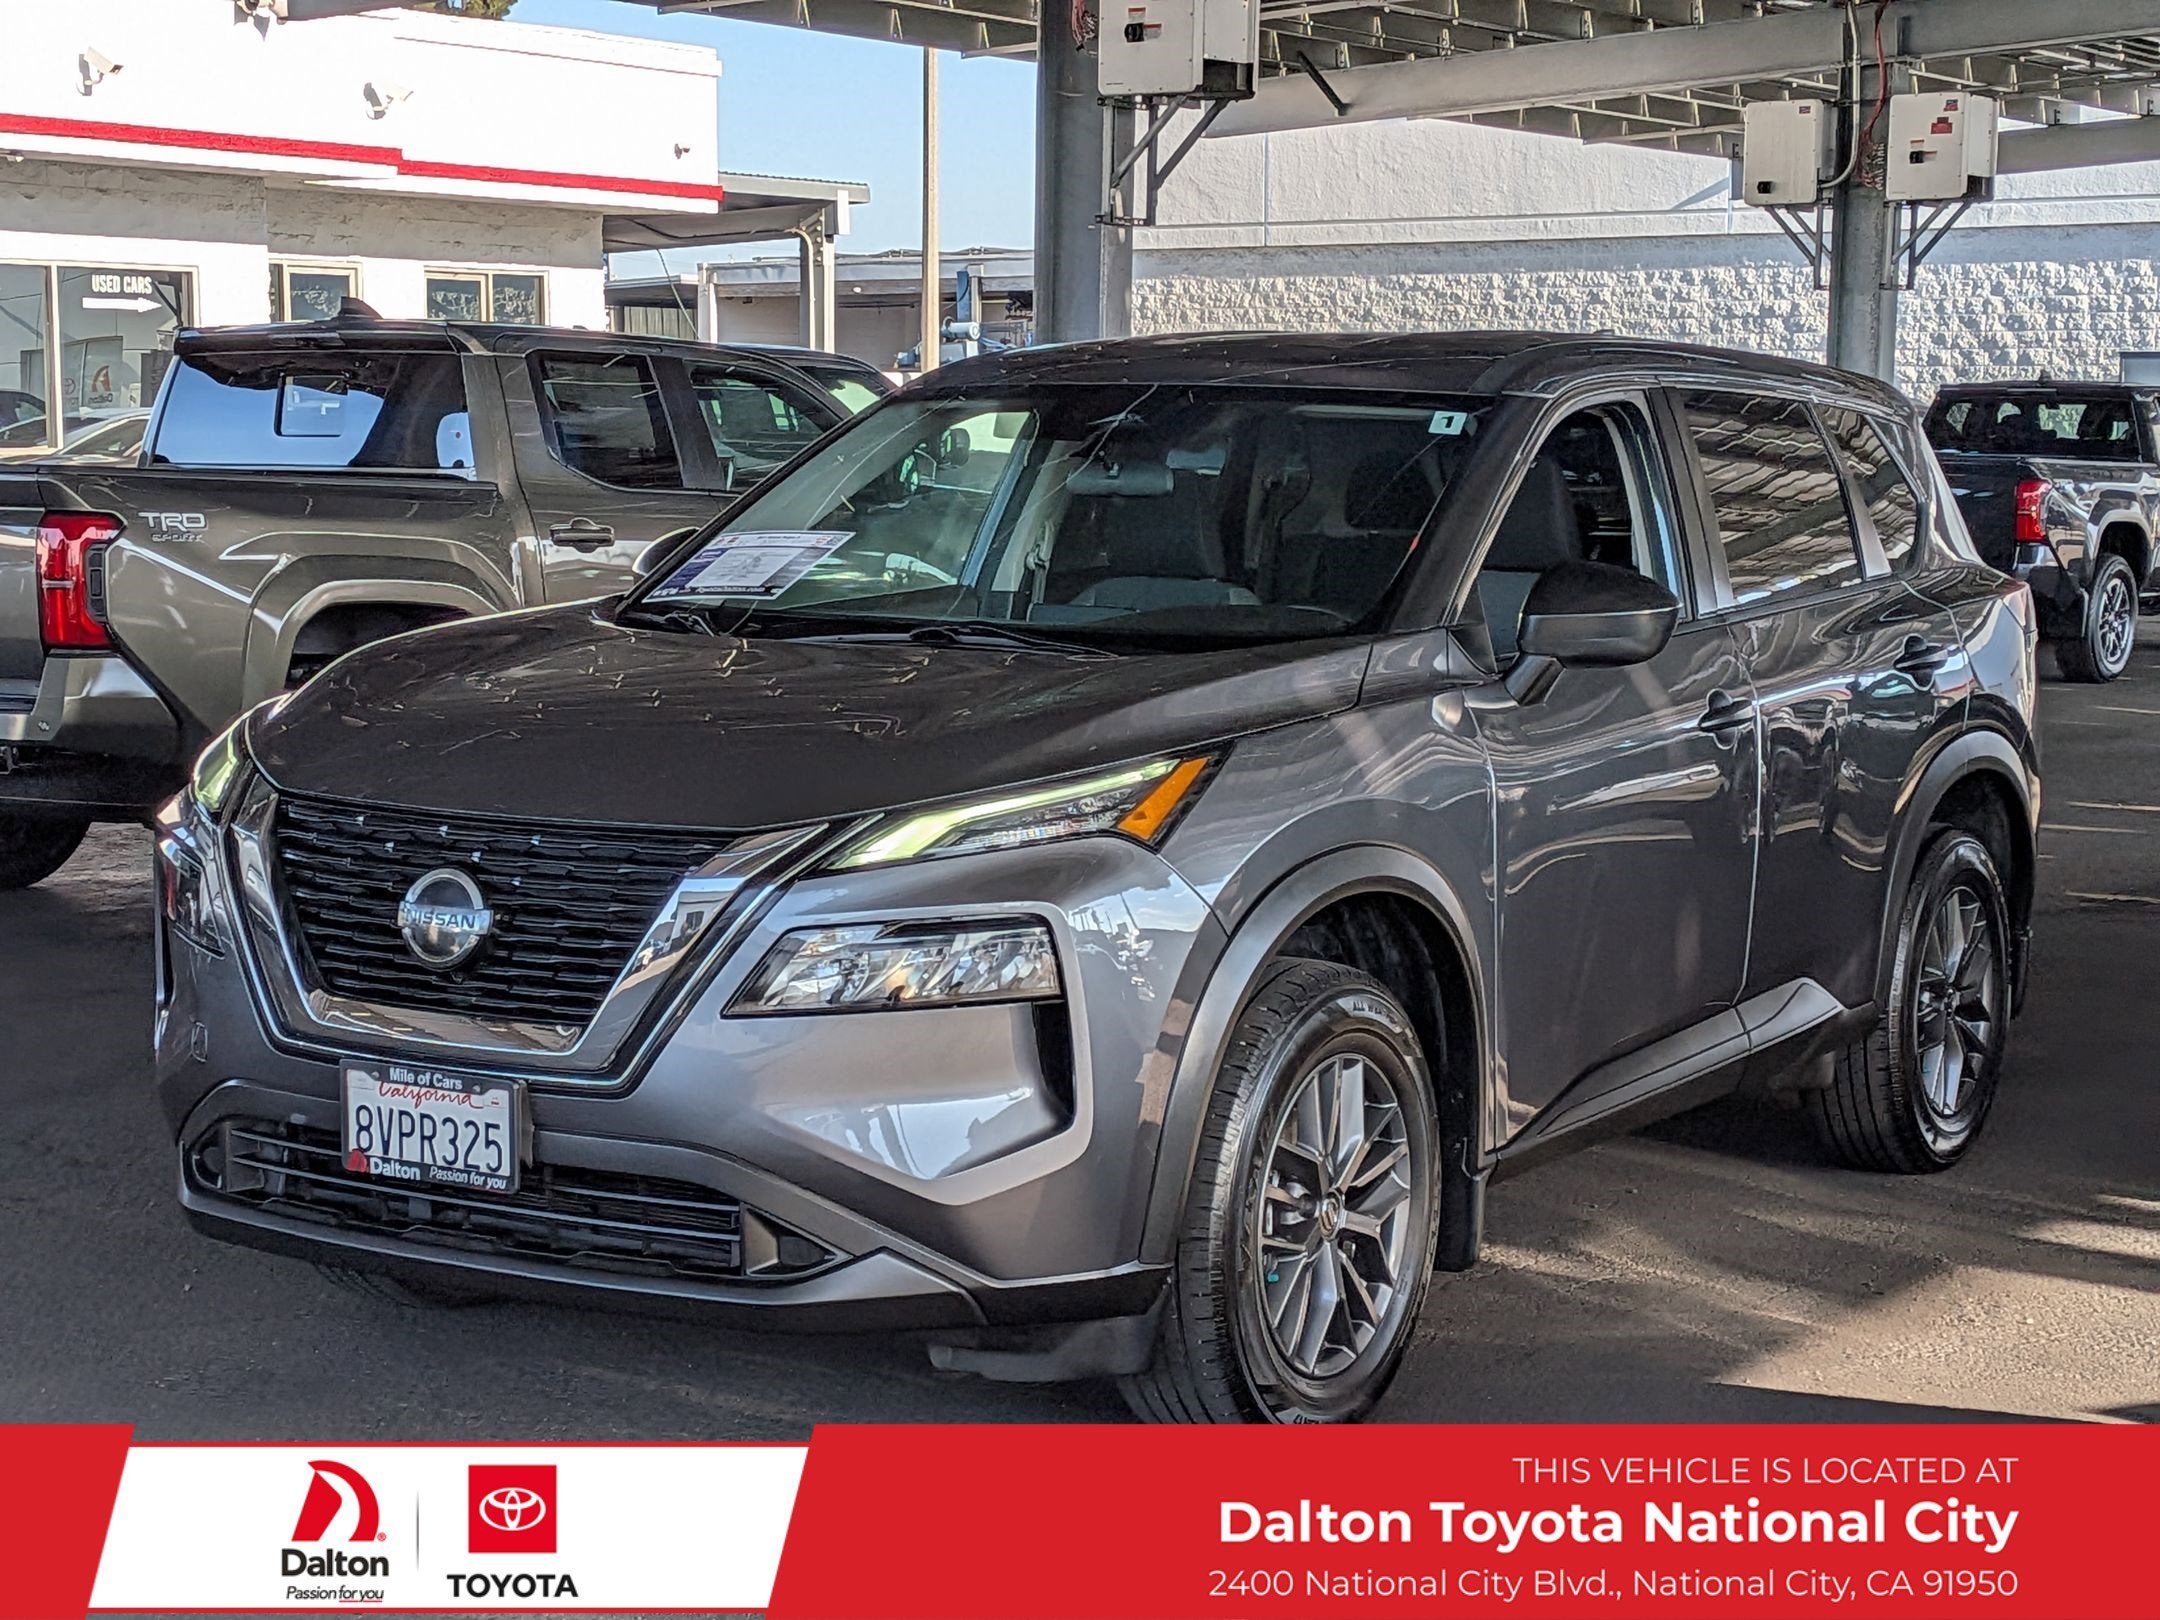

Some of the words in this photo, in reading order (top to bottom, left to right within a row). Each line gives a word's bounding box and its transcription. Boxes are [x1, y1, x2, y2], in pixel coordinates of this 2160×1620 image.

[92, 274, 121, 293] USED
[123, 276, 153, 294] CARS
[1441, 415, 1454, 429] 1
[138, 512, 207, 532] TRD
[405, 909, 477, 929] NISSAN
[389, 1067, 414, 1083] Mile
[417, 1073, 431, 1086] of
[433, 1075, 463, 1090] Cars
[379, 1081, 483, 1109] California
[355, 1104, 503, 1173] 8VPR325
[370, 1156, 421, 1181] Dalton
[429, 1165, 468, 1184] Passion
[469, 1172, 485, 1186] for
[486, 1178, 507, 1190] you
